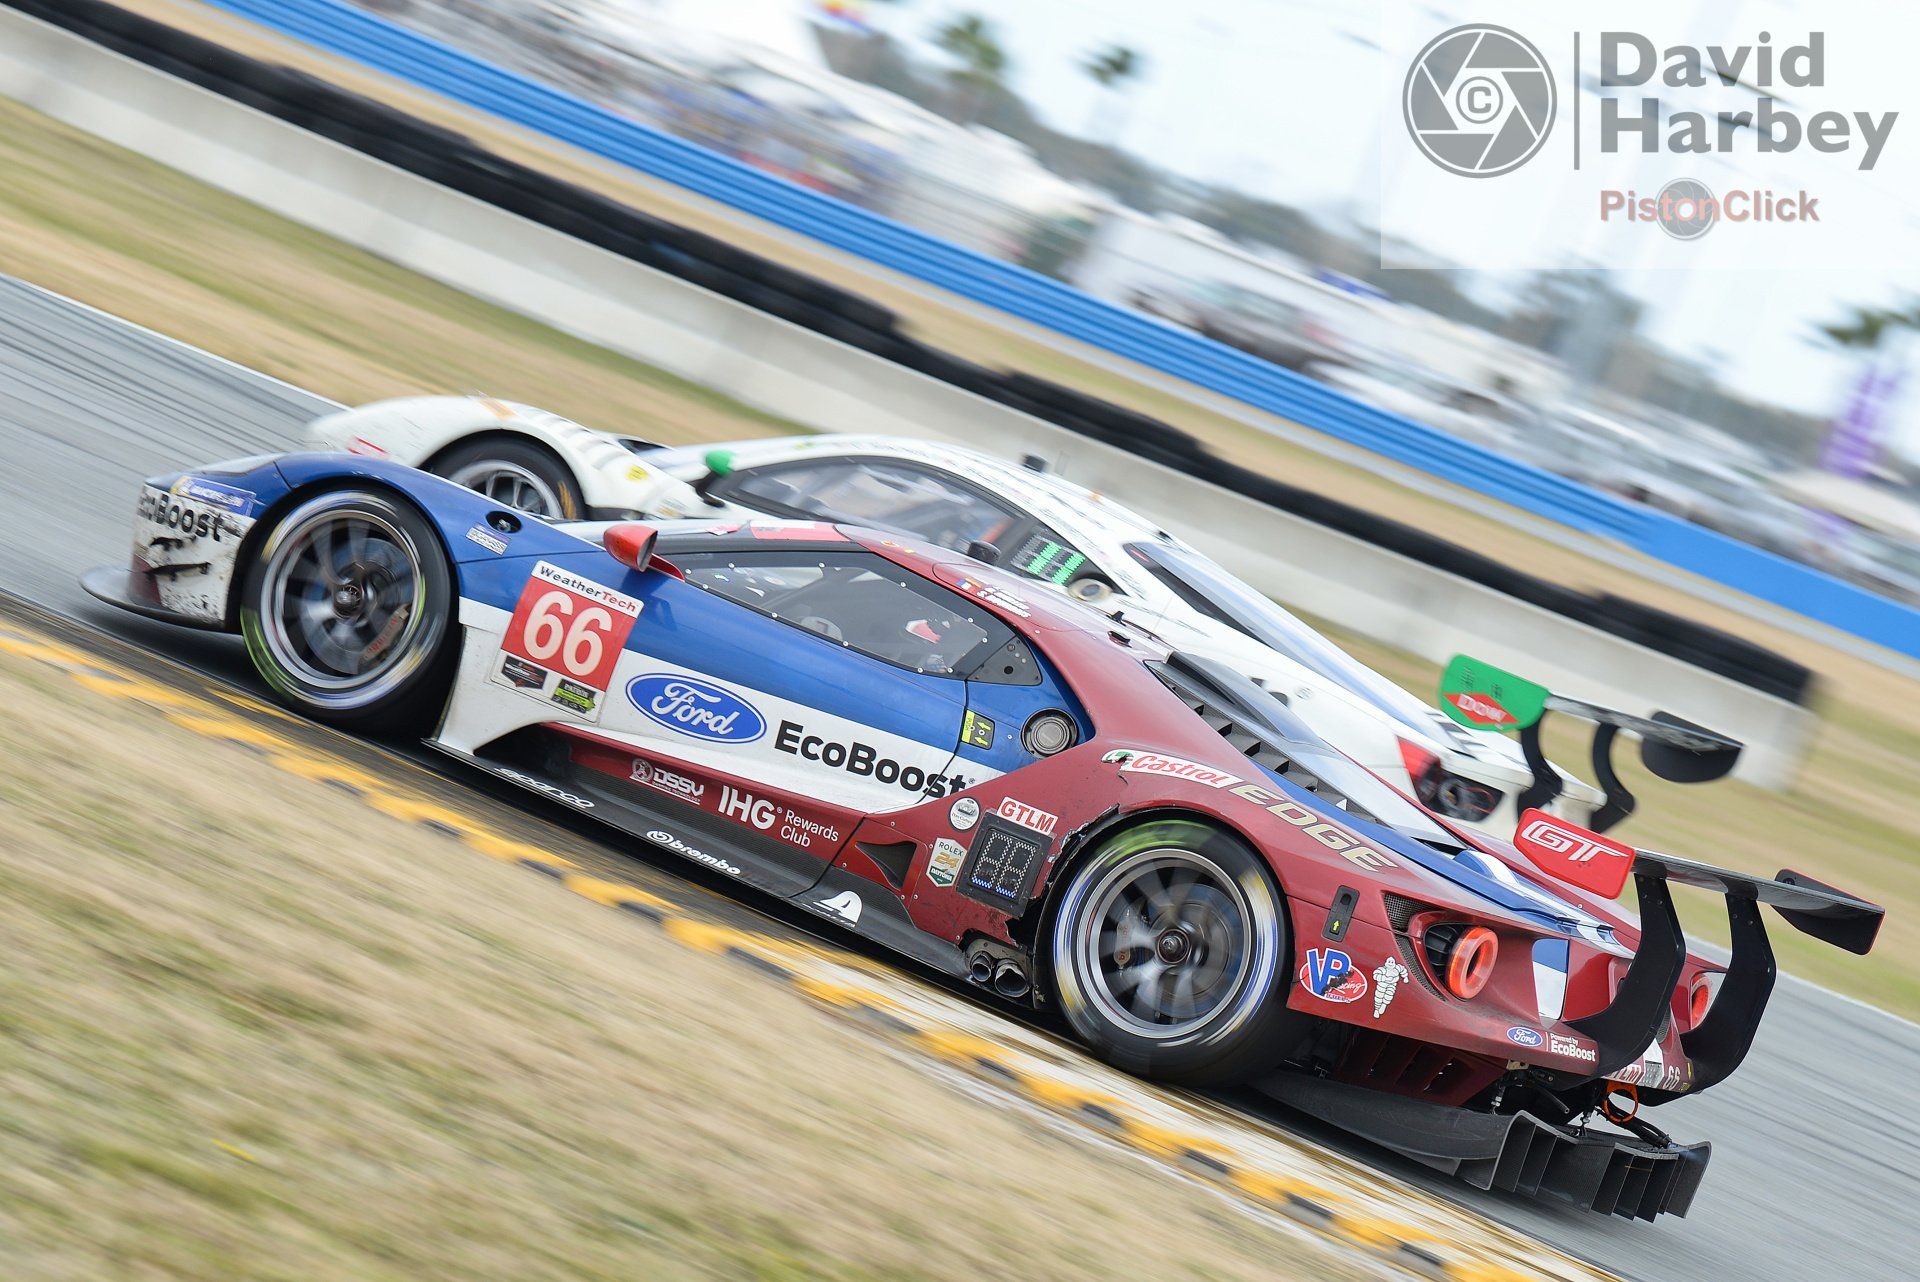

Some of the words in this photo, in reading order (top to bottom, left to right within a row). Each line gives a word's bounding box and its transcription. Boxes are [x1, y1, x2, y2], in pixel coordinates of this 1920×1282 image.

[136, 491, 225, 542] Boost
[540, 565, 637, 612] WeatherTech
[523, 590, 613, 677] 66
[651, 681, 741, 736] Ford
[774, 719, 966, 799] EcoBoost
[1130, 754, 1230, 787] Castrol
[653, 767, 704, 796] DSSV
[718, 784, 776, 830] IHG
[1000, 800, 1055, 833] GTLM
[780, 826, 811, 848] Club
[784, 809, 839, 842] Rewards
[1228, 784, 1399, 873] EDGE
[1520, 820, 1630, 862] GT
[669, 838, 741, 876] brembo
[938, 842, 964, 857] ROLEX
[1306, 948, 1351, 997] VP
[1512, 1029, 1537, 1046] Ford
[1550, 1032, 1572, 1043] Powered
[1550, 1040, 1596, 1062] EcoBoost
[1663, 1065, 1682, 1090] 66
